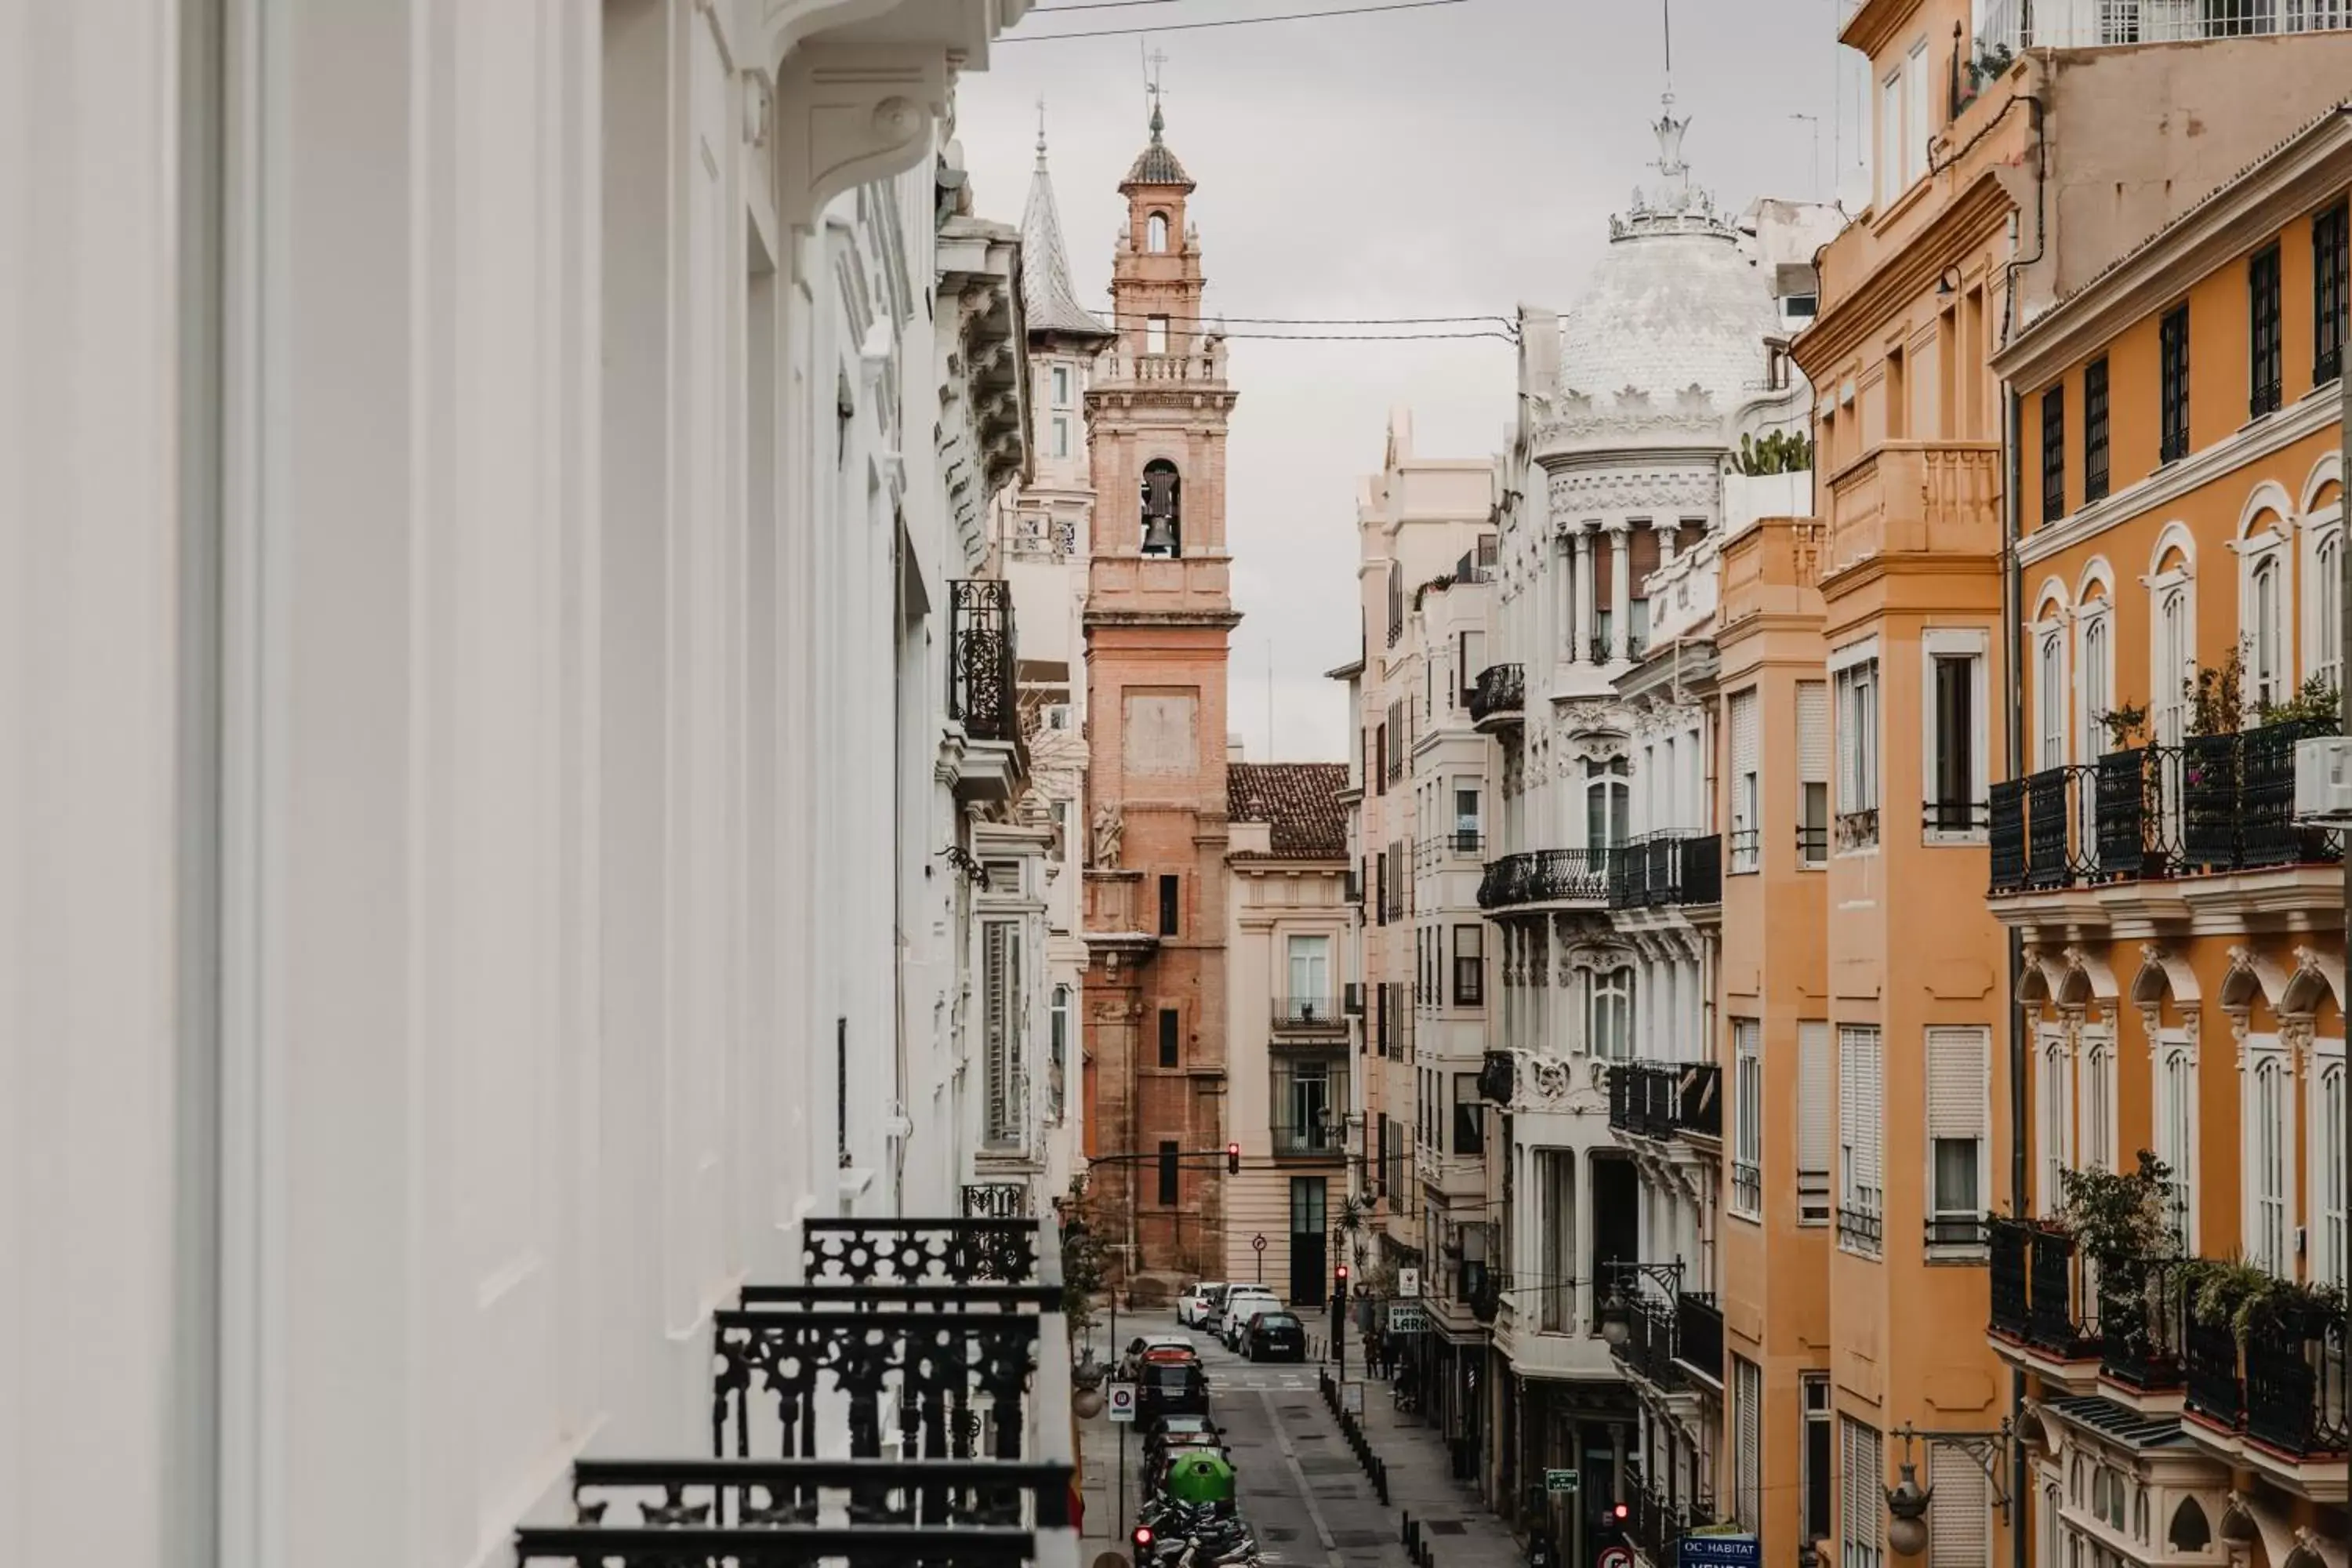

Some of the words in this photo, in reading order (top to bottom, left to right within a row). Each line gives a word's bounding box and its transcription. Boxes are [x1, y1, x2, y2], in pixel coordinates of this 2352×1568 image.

[1393, 1318, 1428, 1330] LARA
[1684, 1542, 1703, 1552] OC
[1708, 1543, 1755, 1555] HABITAT
